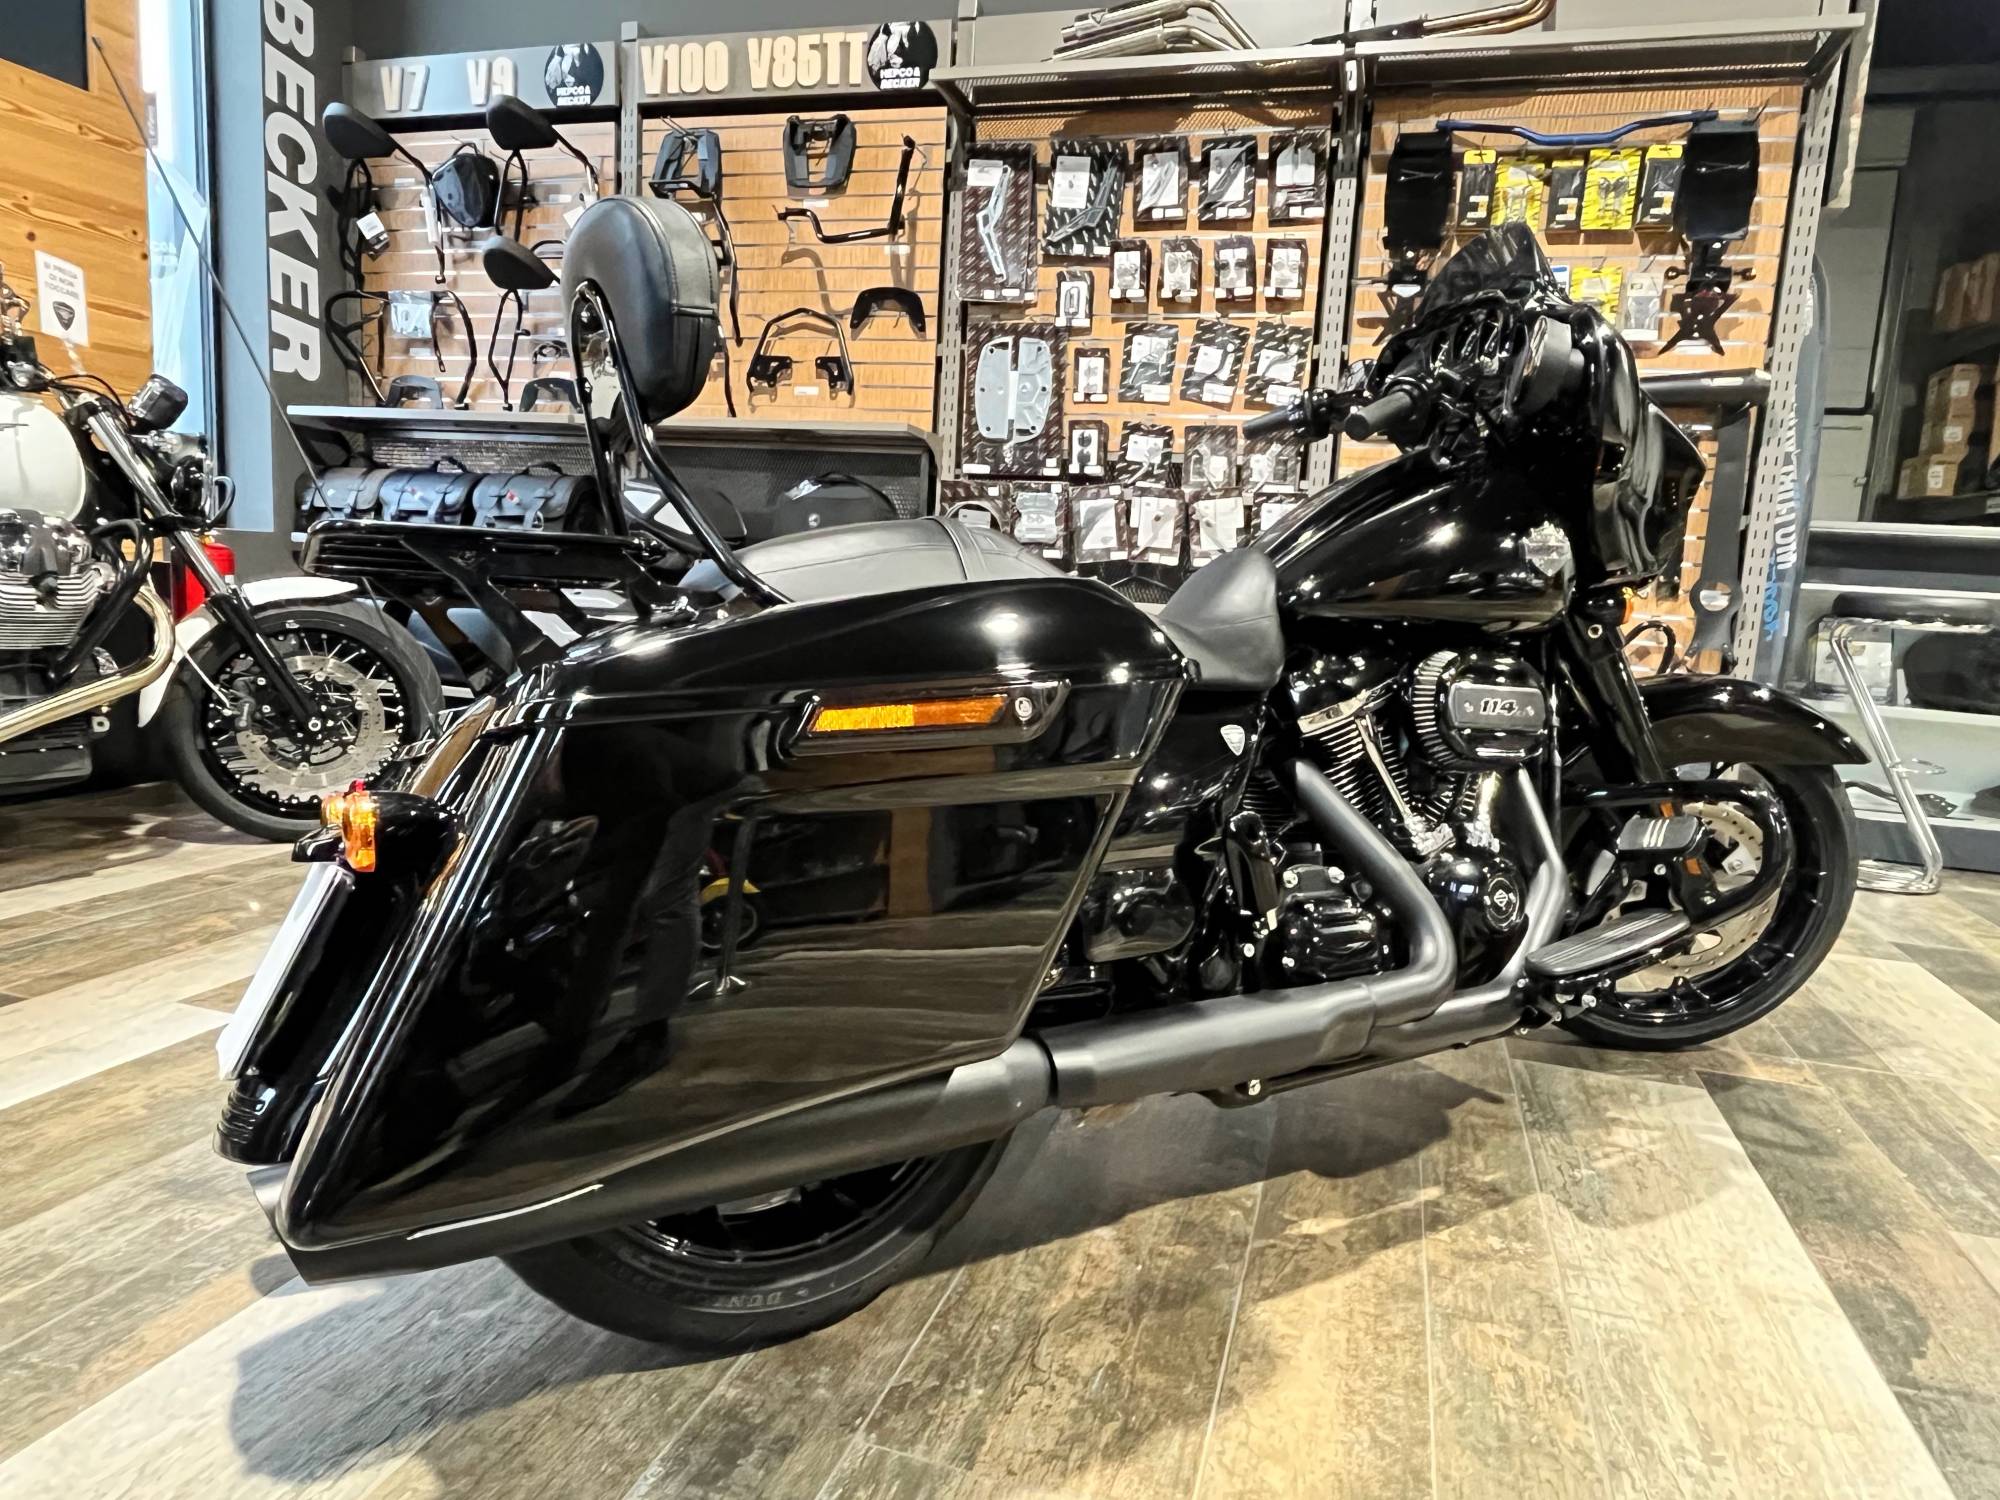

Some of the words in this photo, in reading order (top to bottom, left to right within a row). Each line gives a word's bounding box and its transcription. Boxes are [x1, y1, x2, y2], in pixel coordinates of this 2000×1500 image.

[380, 64, 430, 112] V7
[466, 56, 516, 106] V9
[640, 40, 729, 95] V100
[747, 31, 868, 89] V85TT
[1479, 697, 1518, 716] 114
